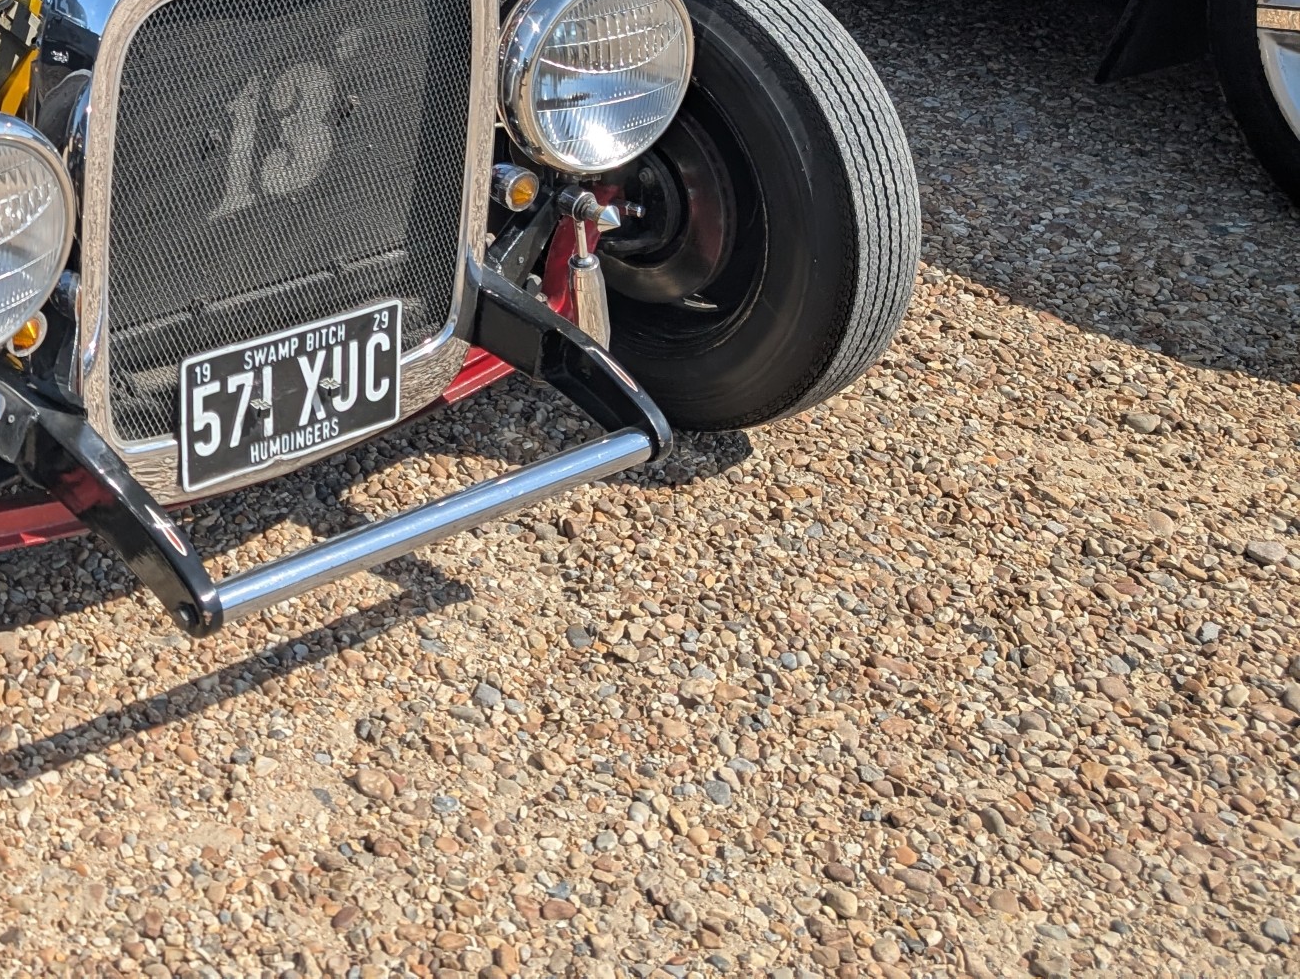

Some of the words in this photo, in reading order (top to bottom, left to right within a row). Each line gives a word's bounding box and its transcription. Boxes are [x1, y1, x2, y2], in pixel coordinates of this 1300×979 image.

[373, 310, 389, 331] 29
[244, 337, 299, 370] SWAMP
[306, 323, 346, 352] BITCH
[192, 365, 274, 457] 571
[297, 331, 391, 427] XUC
[194, 362, 212, 384] 19
[250, 418, 339, 464] HUMDINGERS
